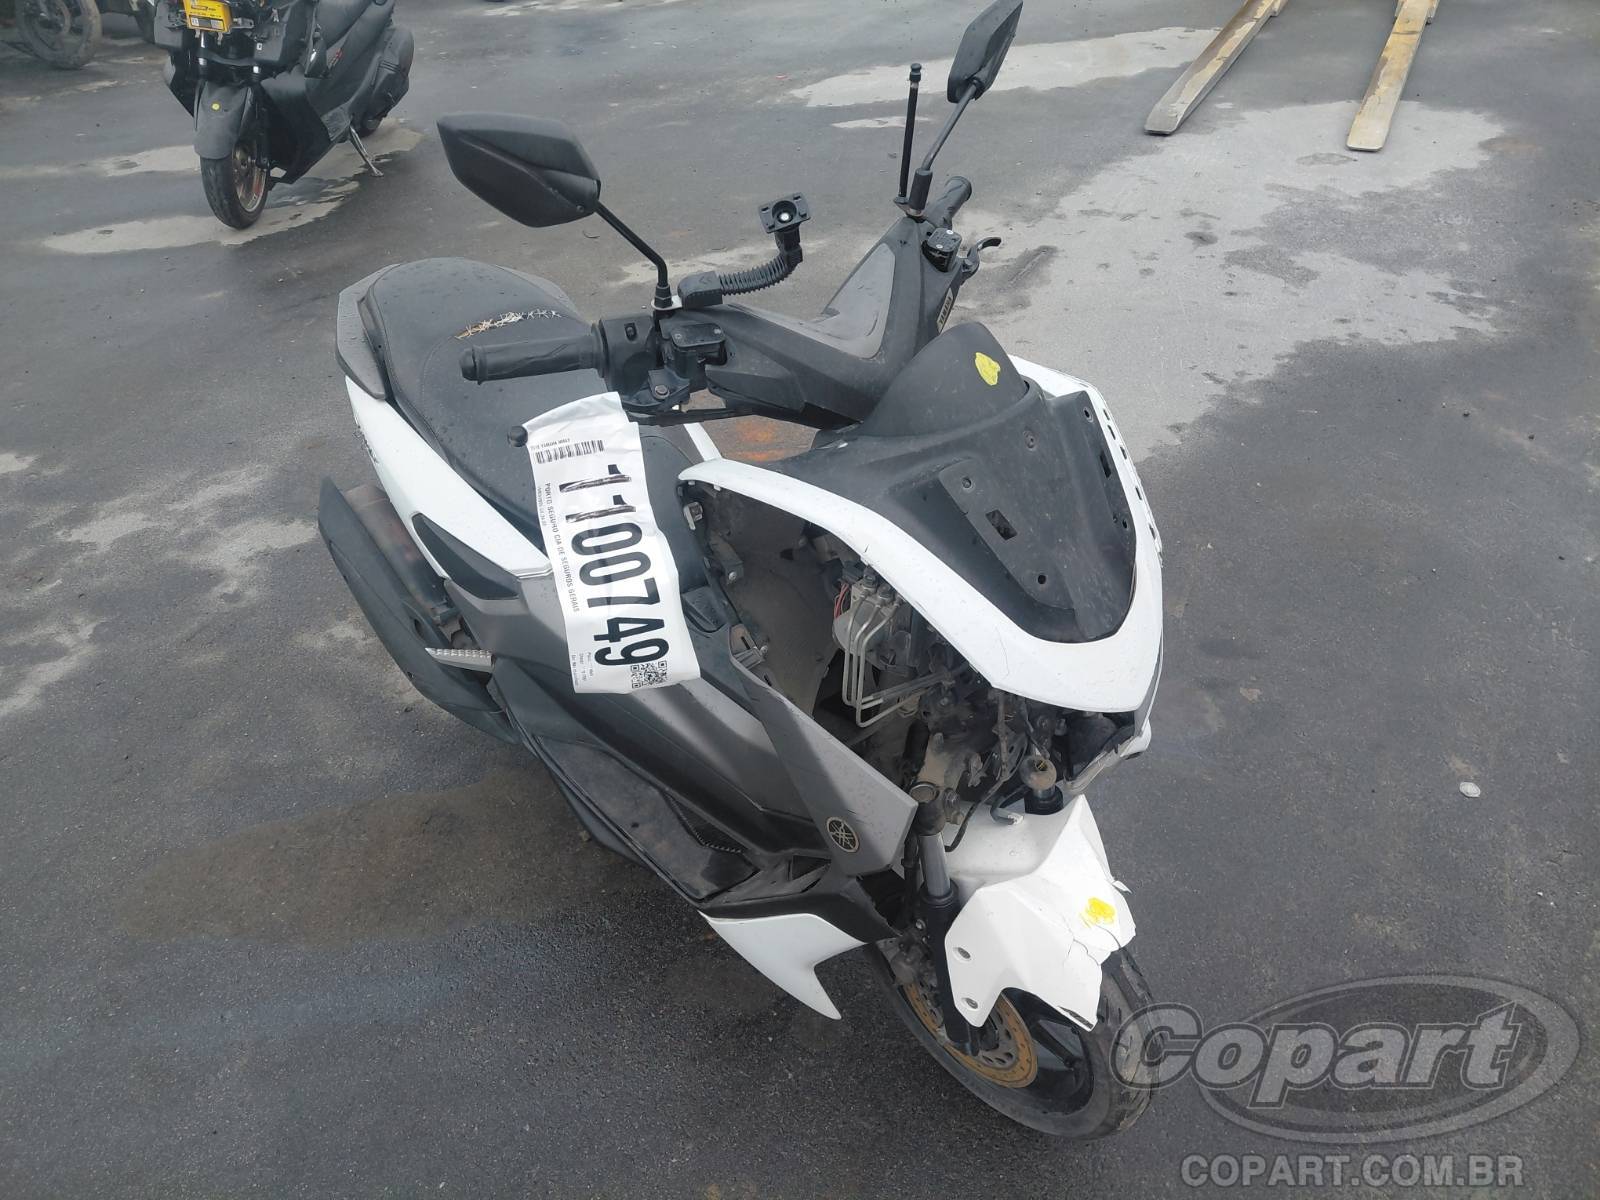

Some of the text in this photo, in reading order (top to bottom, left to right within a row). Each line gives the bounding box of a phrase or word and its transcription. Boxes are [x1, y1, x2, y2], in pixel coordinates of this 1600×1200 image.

[545, 482, 553, 505] PORTO
[547, 506, 559, 533] SEGURO
[554, 534, 562, 545] CIA
[556, 546, 565, 556] DE
[559, 464, 670, 666] 1100749
[560, 557, 574, 588] SEGUROS
